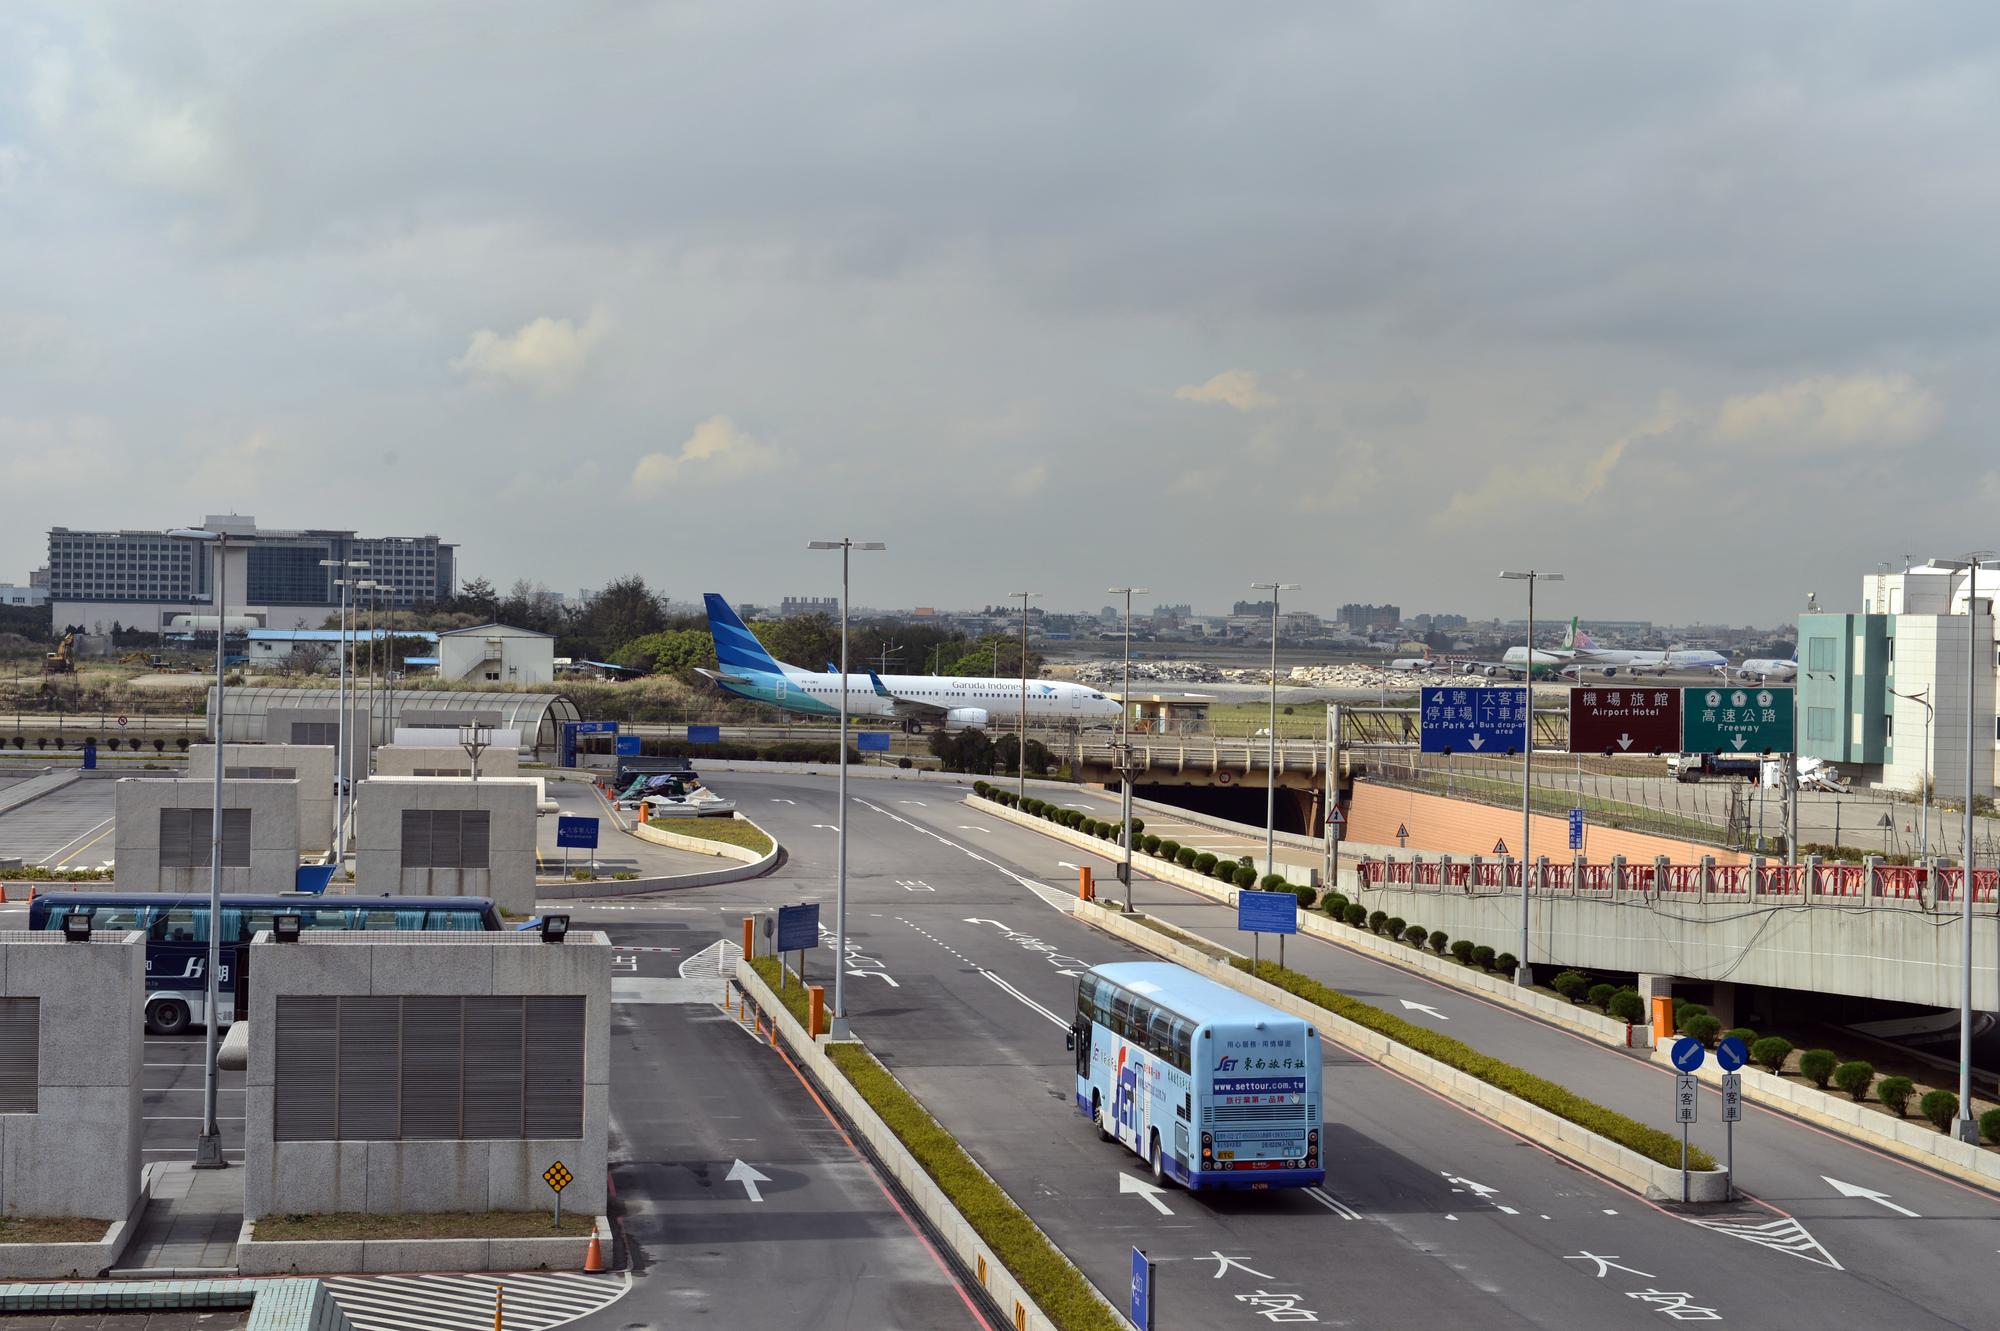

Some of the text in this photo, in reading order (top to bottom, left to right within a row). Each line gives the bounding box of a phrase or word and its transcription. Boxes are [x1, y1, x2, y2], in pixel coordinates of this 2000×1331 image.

[952, 680, 1031, 691] Garuda Indonesa
[1481, 691, 1527, 706] 大客車
[1582, 691, 1669, 706] 機場旅館
[1710, 695, 1716, 703] 2
[1762, 695, 1767, 703] 3
[1426, 706, 1473, 721] 停車場
[1481, 706, 1526, 721] 下車處
[1592, 708, 1659, 716] Airport Hotel
[1702, 708, 1776, 723] 高速公路
[1422, 721, 1475, 729] Car Park 4
[1497, 721, 1526, 729] drop-of
[1717, 723, 1759, 733] Freeway
[1213, 1055, 1239, 1072] SET
[1243, 1057, 1305, 1071] 東南旅行社
[1214, 1081, 1304, 1091] www.settour.com.tw
[1680, 1077, 1693, 1121] 大客車
[1725, 1076, 1738, 1119] 小客車
